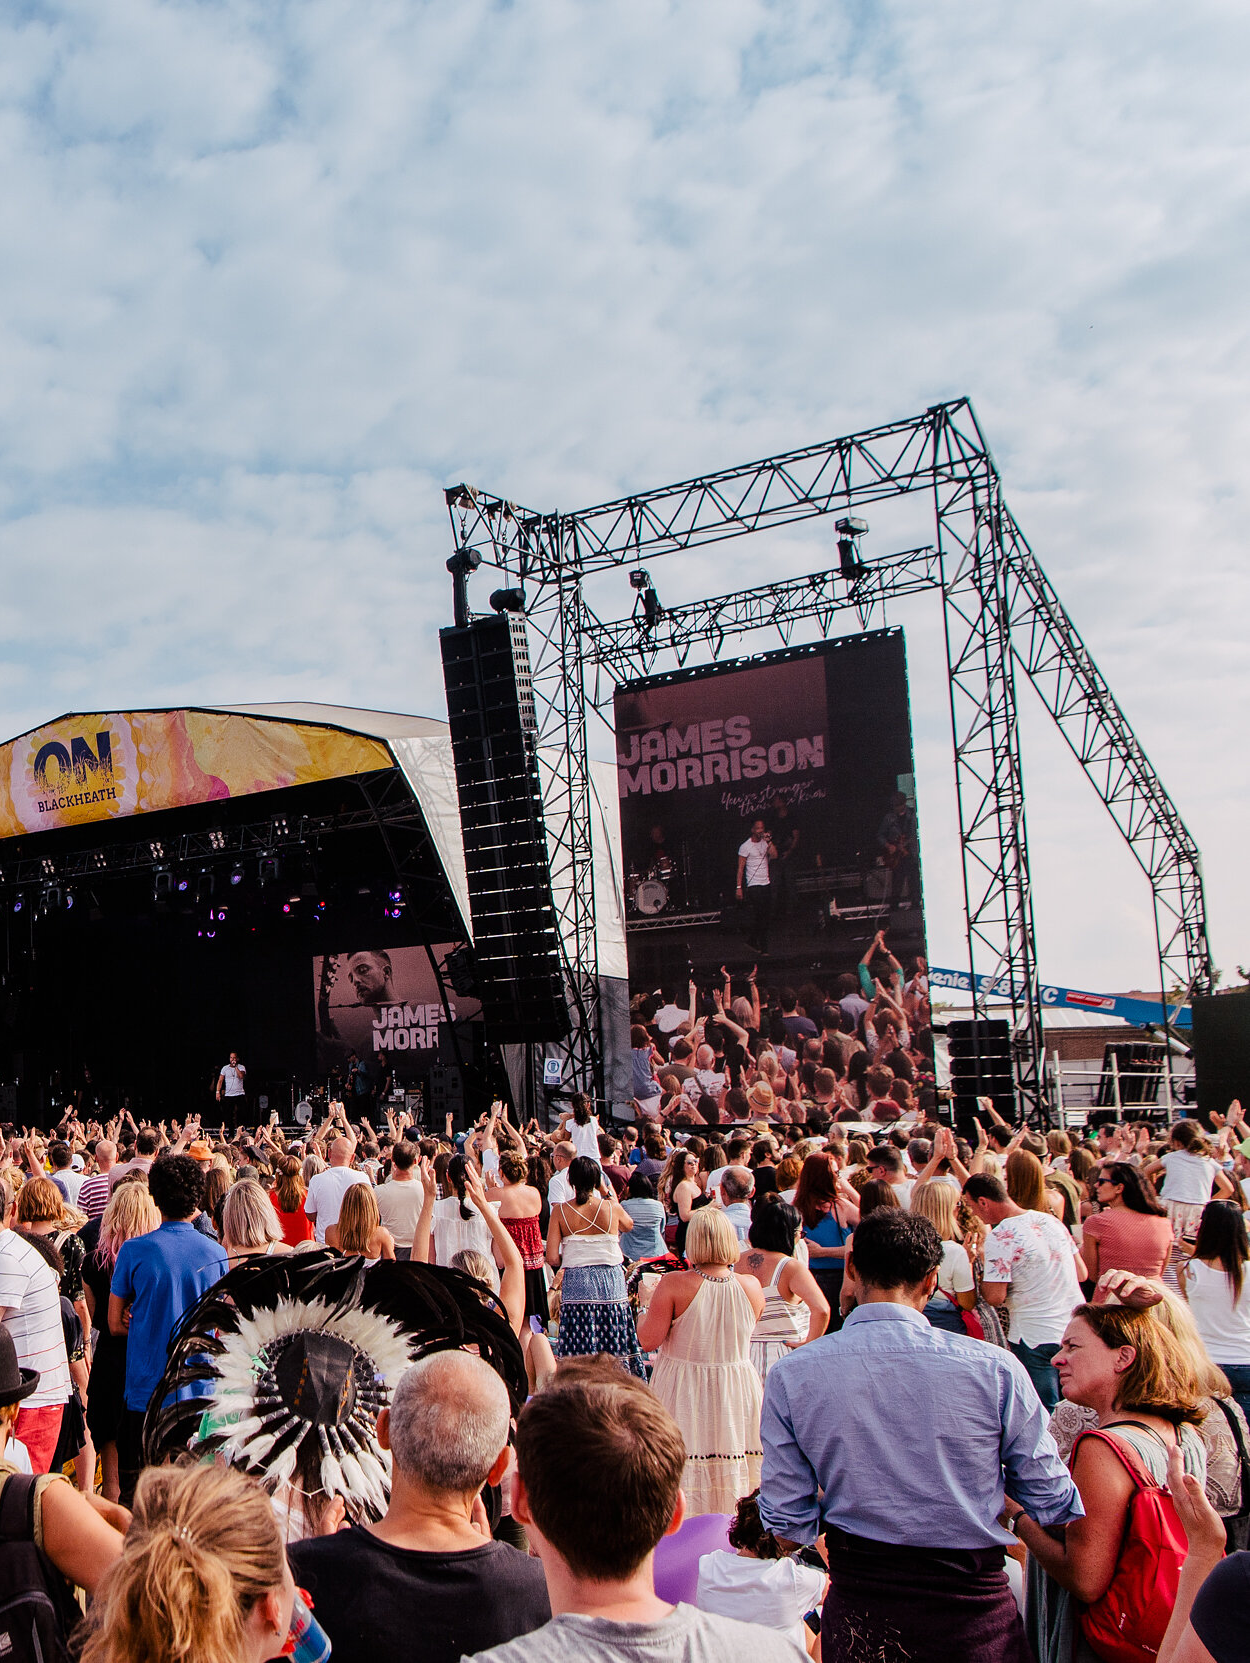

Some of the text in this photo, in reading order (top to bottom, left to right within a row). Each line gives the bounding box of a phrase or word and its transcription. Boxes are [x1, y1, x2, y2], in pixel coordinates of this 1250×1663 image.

[33, 731, 115, 794] ON
[617, 715, 751, 766] JAMES
[619, 735, 826, 798] MORRISON
[37, 787, 117, 813] BLACKHEATH
[372, 1003, 457, 1029] JAMES
